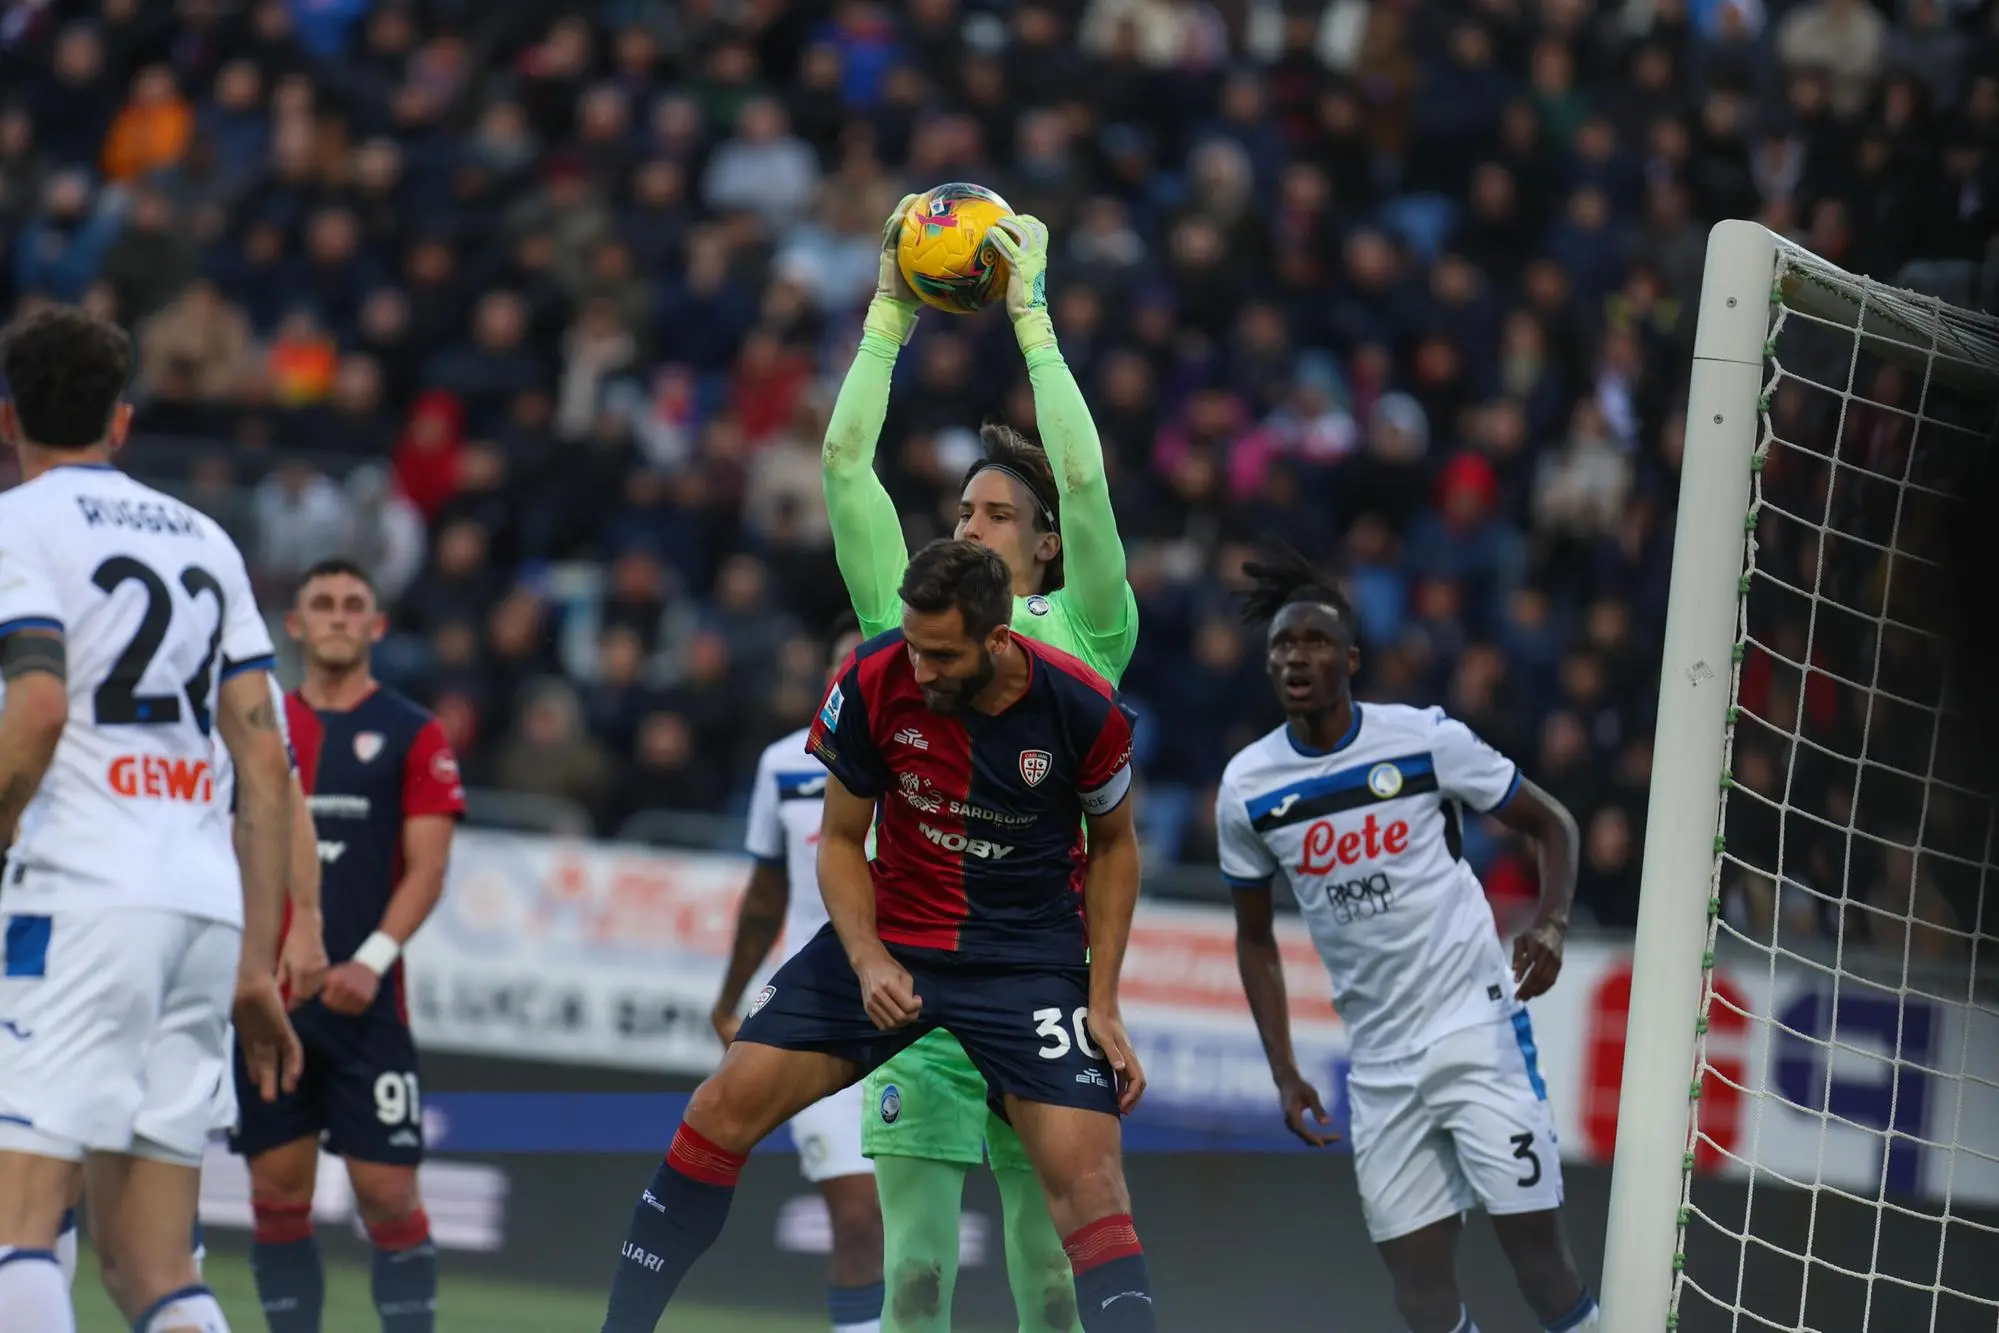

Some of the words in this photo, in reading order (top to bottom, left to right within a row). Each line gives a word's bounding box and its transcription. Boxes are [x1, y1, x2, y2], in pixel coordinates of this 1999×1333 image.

[91, 555, 226, 738] 22
[949, 801, 1038, 825] SARDEGNA
[919, 822, 1015, 860] MOBY
[1295, 813, 1409, 876] Lete
[1032, 1006, 1105, 1061] 30
[373, 1071, 421, 1126] 91
[1510, 1131, 1542, 1188] 3
